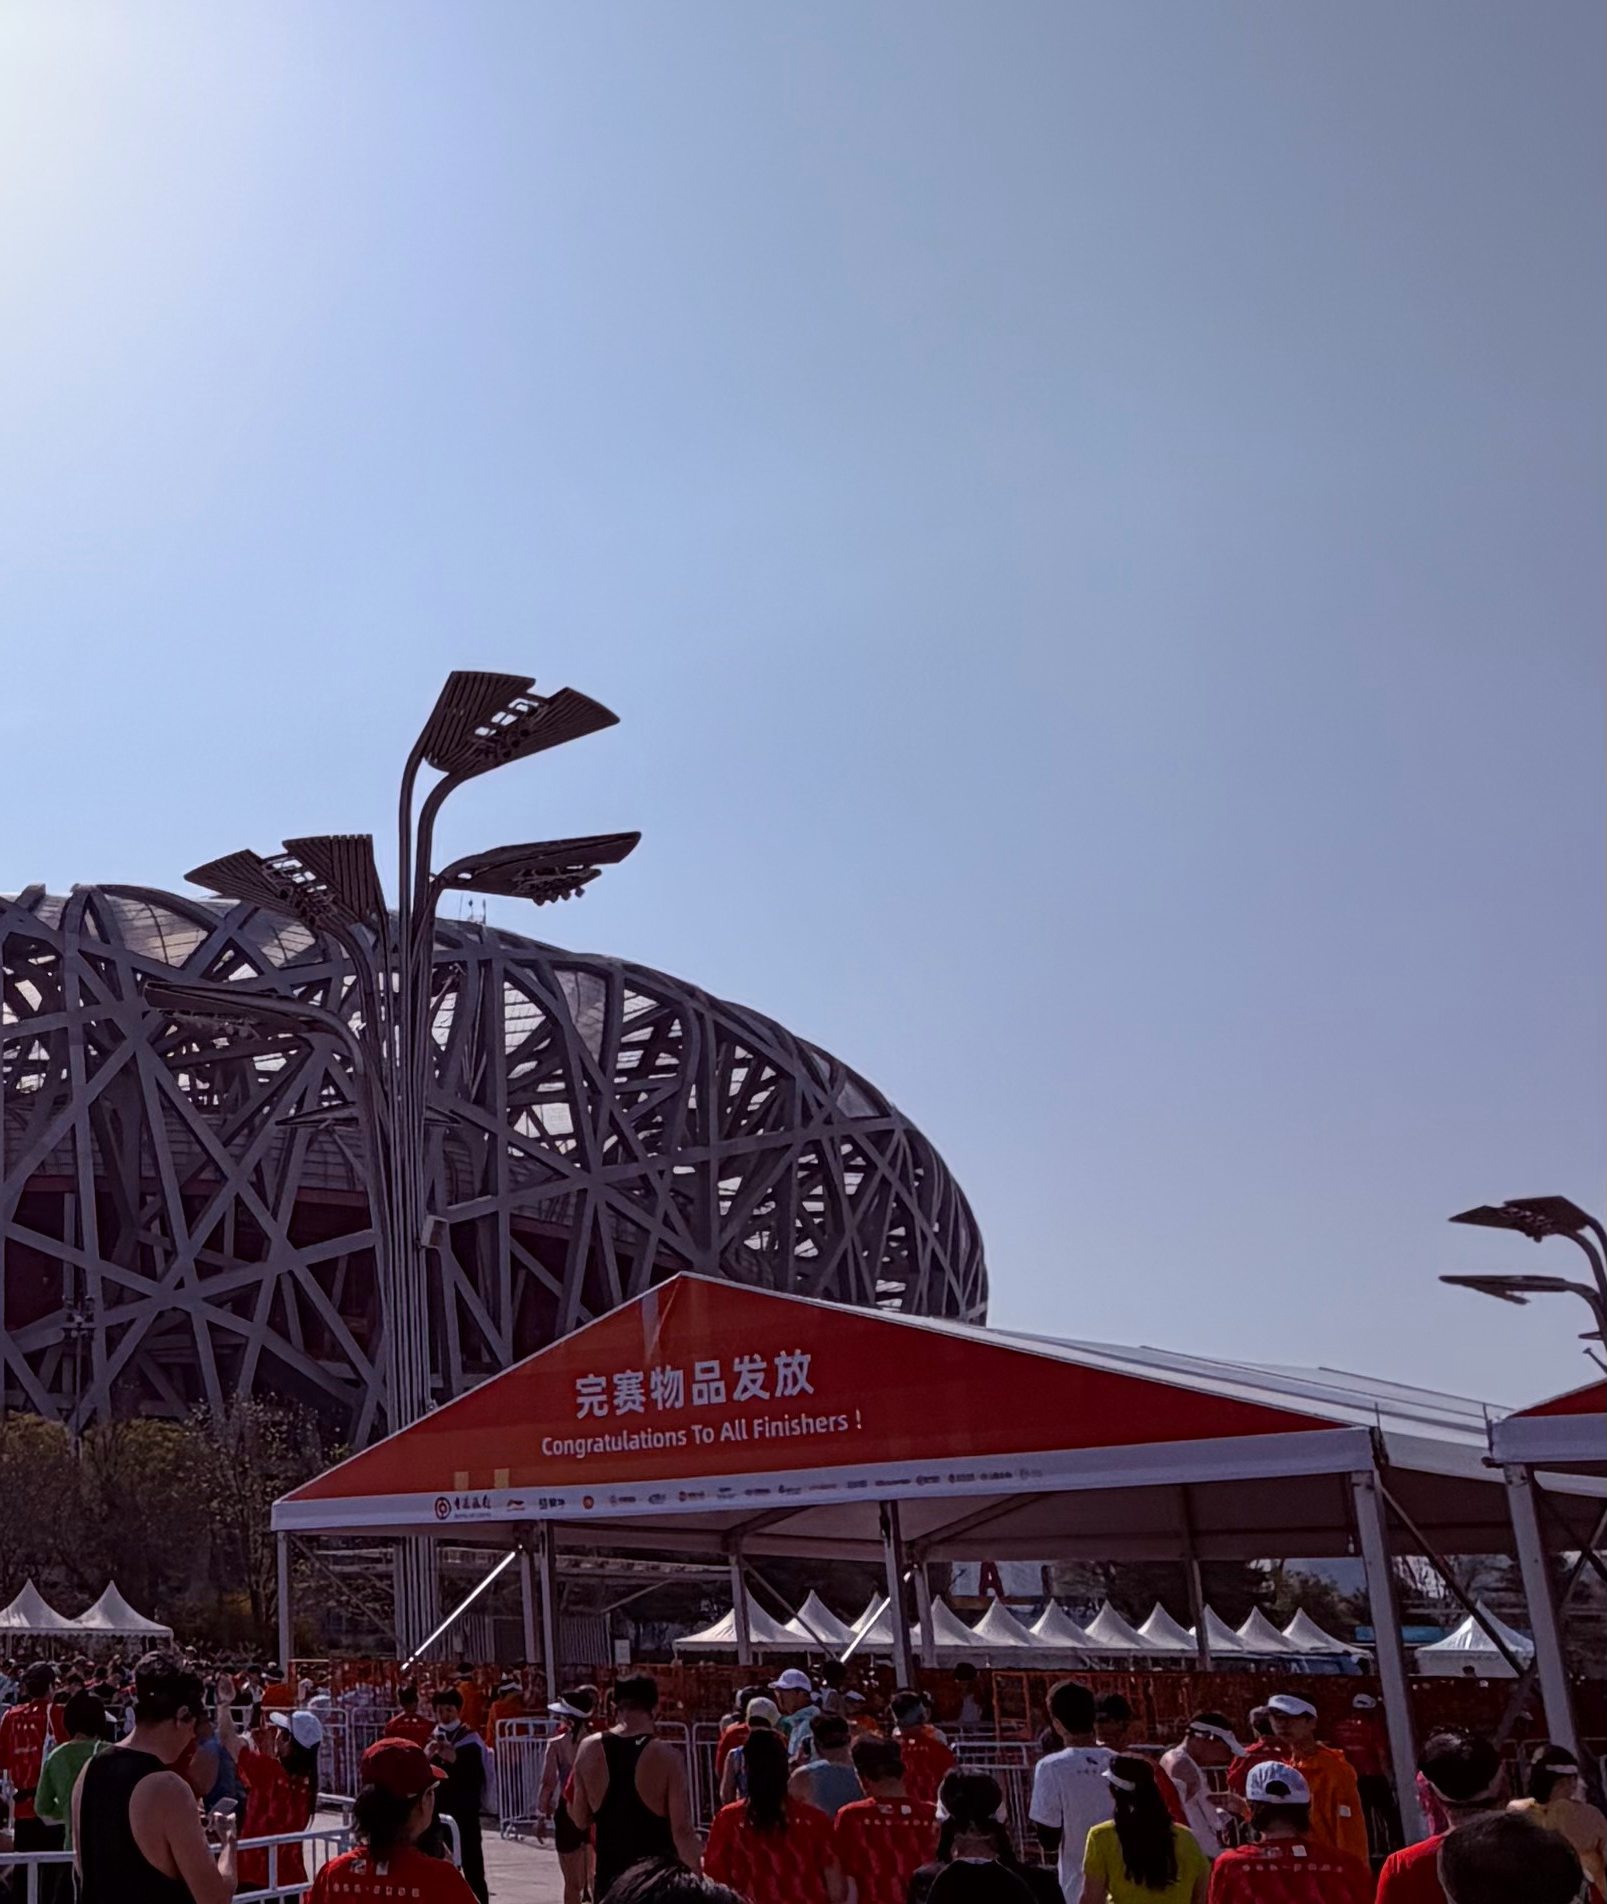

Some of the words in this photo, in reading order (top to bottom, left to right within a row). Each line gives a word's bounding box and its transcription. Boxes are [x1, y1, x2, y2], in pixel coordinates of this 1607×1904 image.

[575, 1348, 814, 1419] 完赛物品发放
[541, 1427, 687, 1459] Congratulations
[691, 1424, 715, 1445] To
[719, 1418, 746, 1442] All
[753, 1410, 849, 1439] Finishers
